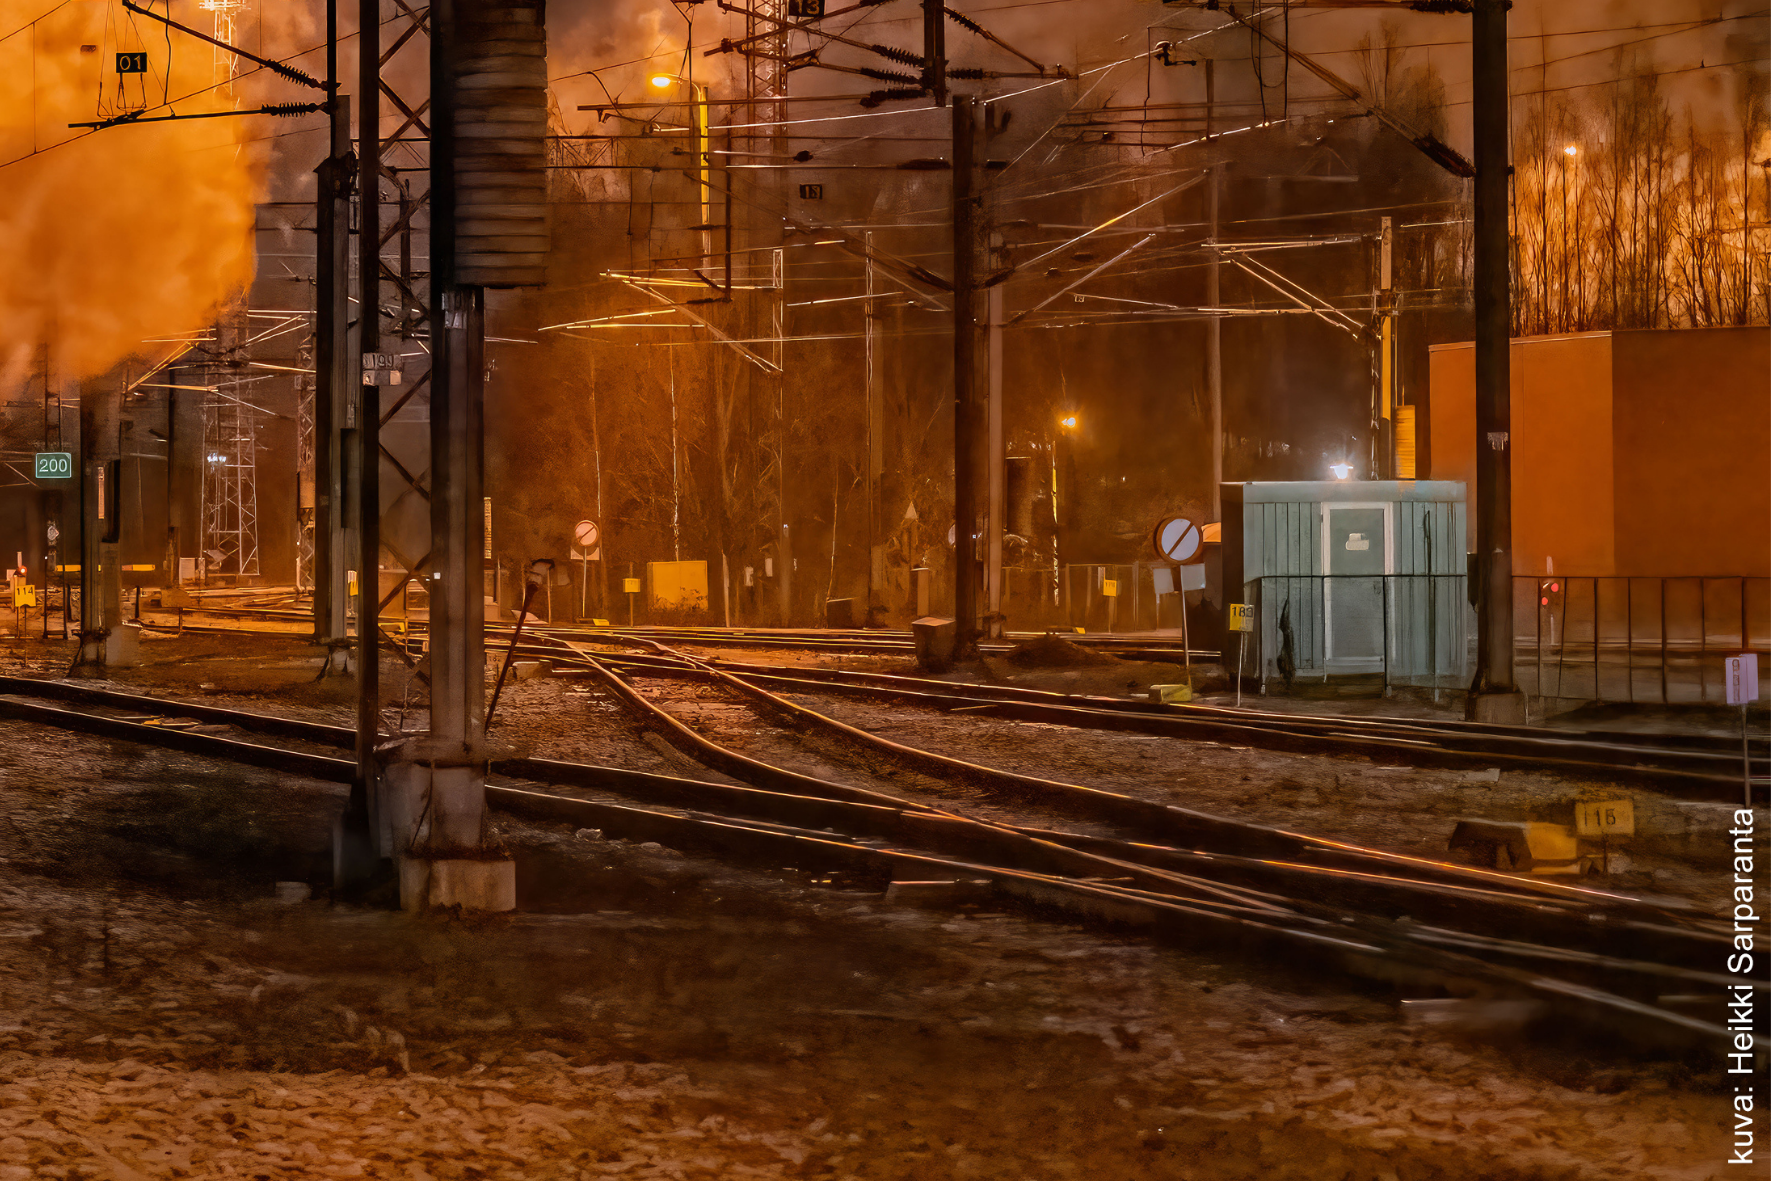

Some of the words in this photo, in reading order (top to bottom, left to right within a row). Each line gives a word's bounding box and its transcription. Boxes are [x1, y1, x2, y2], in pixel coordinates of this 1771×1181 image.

[119, 55, 142, 70] 01
[39, 458, 68, 472] 200
[16, 586, 34, 595] 114
